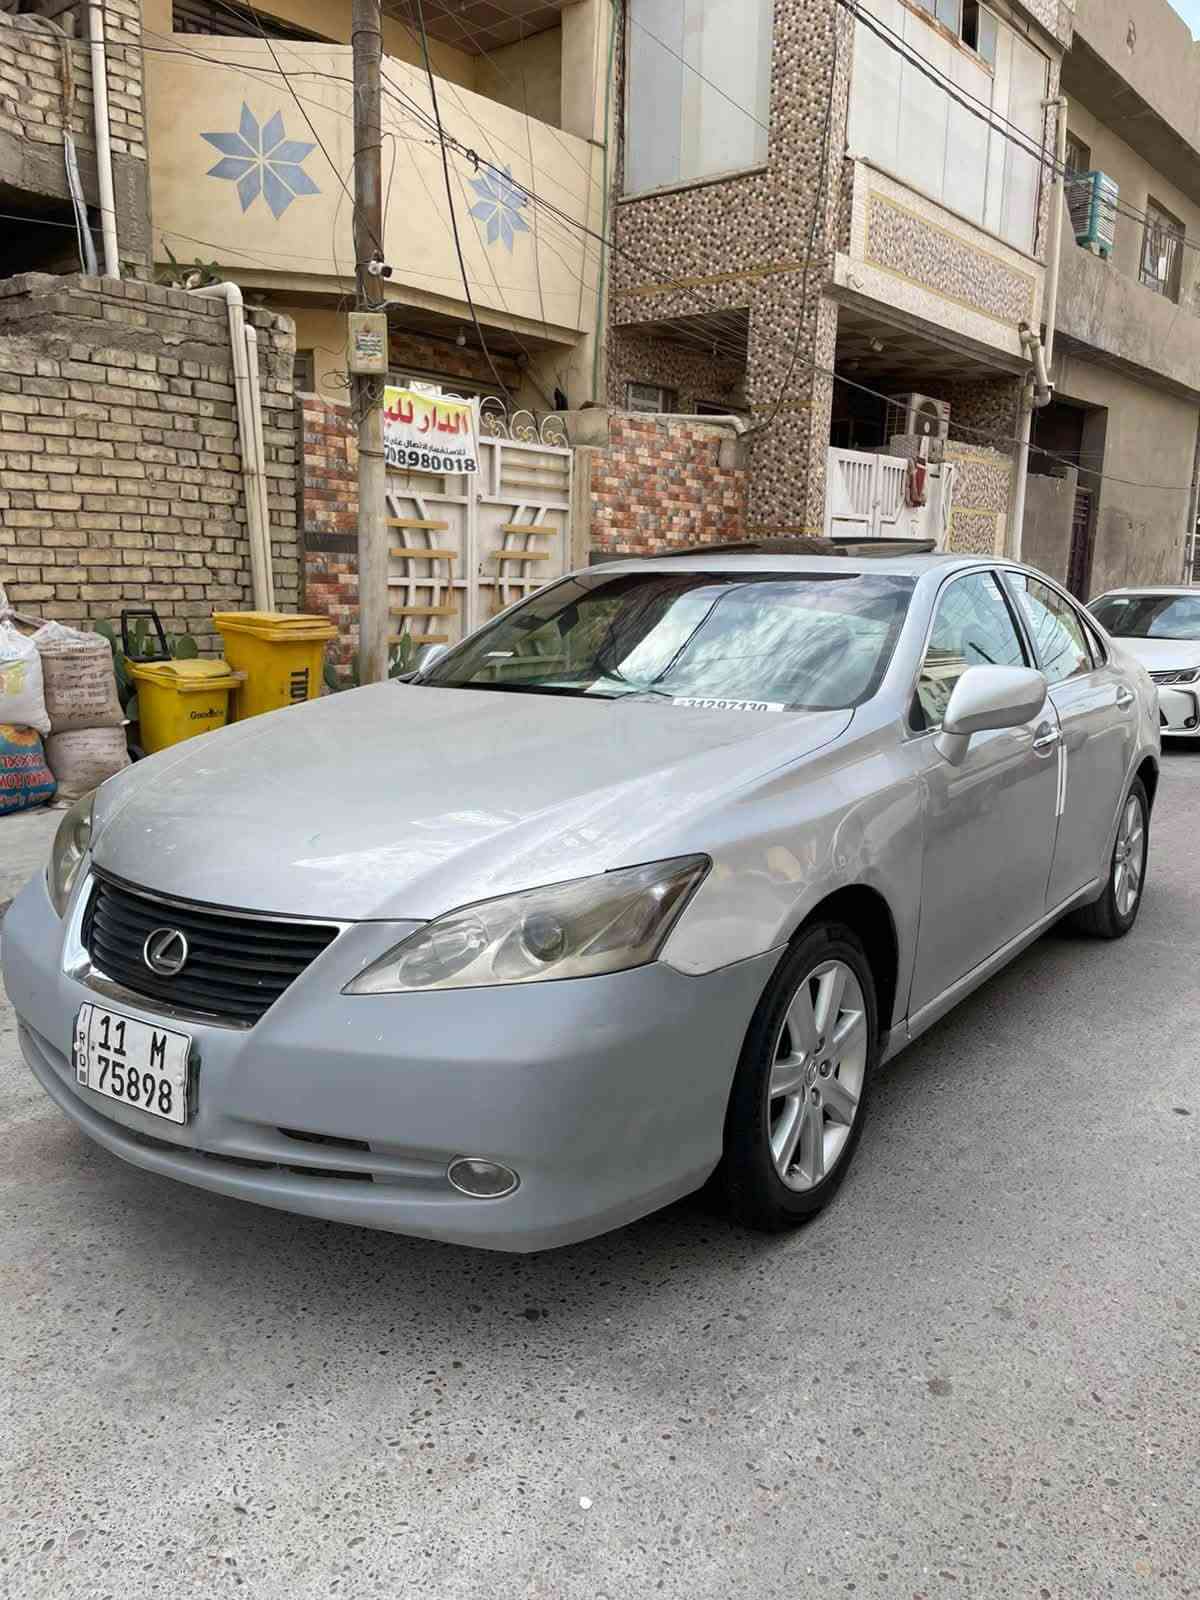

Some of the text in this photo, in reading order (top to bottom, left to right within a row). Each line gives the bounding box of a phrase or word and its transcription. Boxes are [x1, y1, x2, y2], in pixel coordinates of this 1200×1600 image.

[418, 404, 469, 434] الدار
[98, 1015, 168, 1071] 11 M
[97, 1054, 173, 1115] 75898
